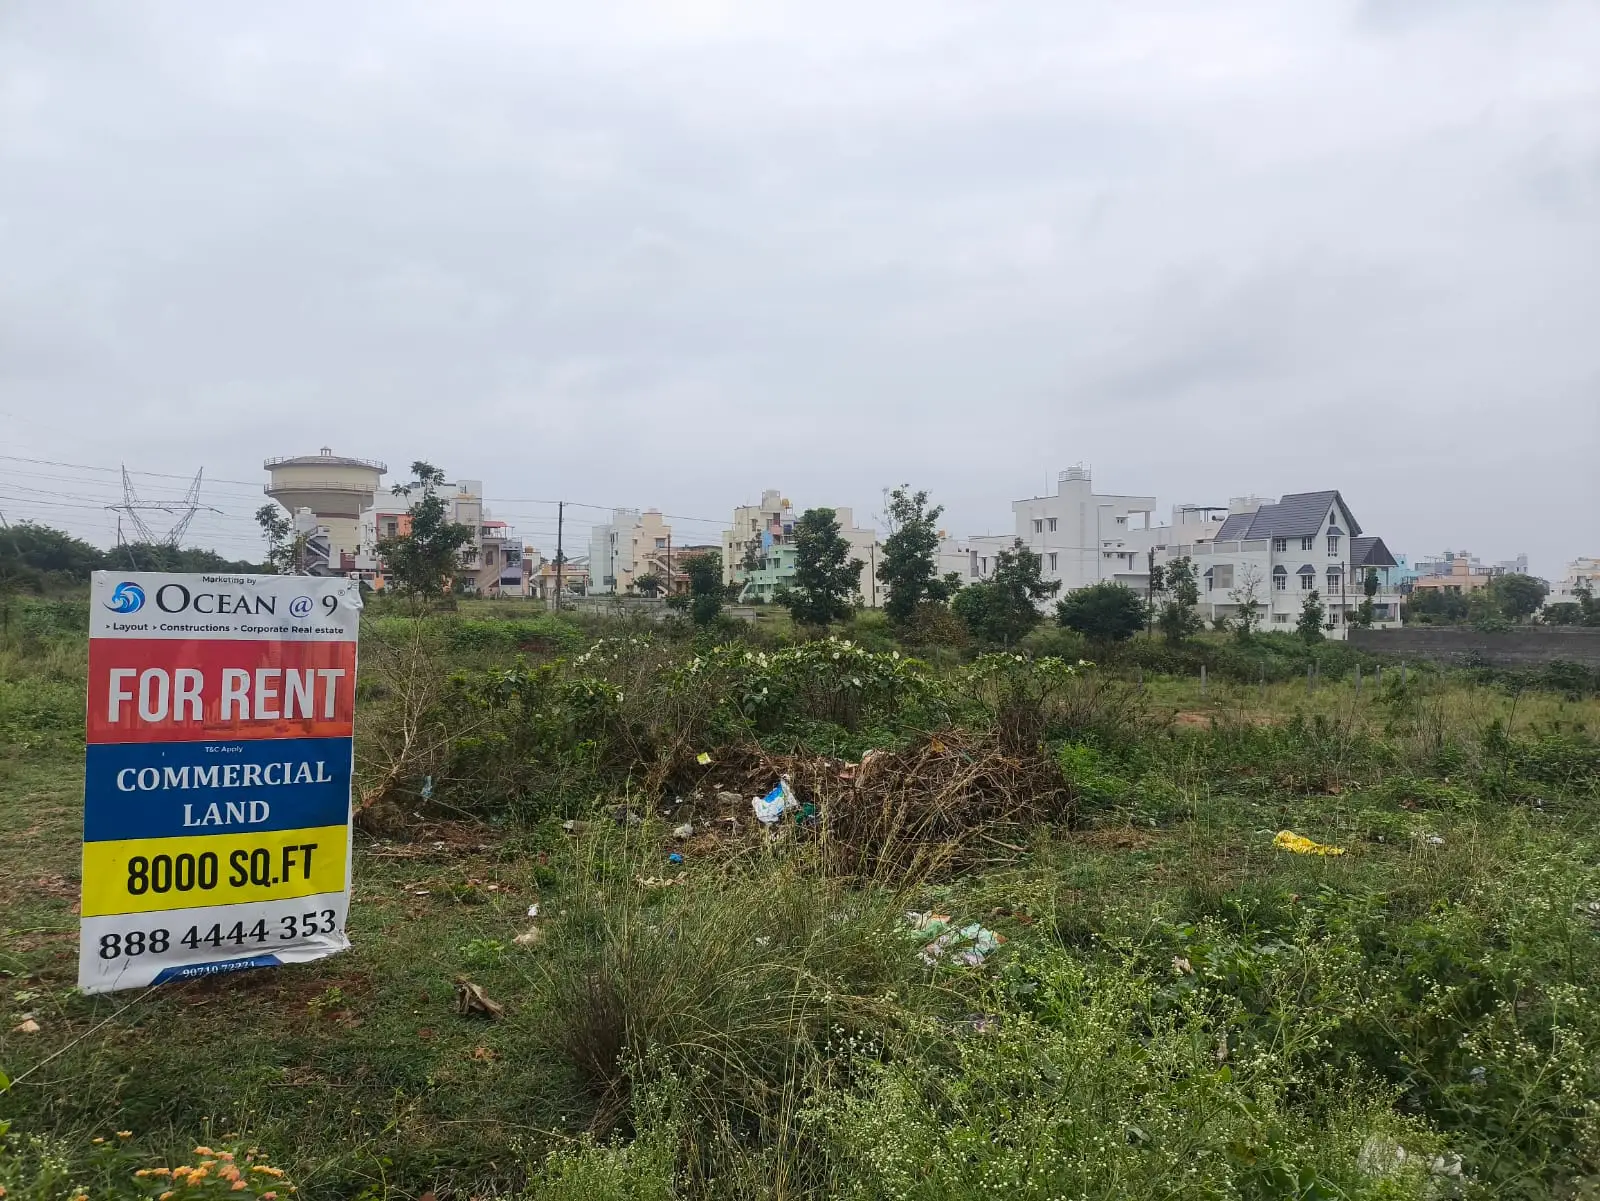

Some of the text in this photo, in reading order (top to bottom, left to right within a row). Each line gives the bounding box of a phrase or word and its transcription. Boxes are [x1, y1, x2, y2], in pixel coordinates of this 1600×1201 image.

[202, 576, 257, 586] Marketing by
[289, 596, 314, 618] @
[113, 623, 344, 635] Layout Constructions Corporate Real estate
[108, 668, 345, 723] FOR RENT
[221, 745, 243, 754] Apply
[116, 761, 332, 792] COMMERCIAL
[183, 800, 270, 827] LAND
[127, 843, 318, 896] 8000 SQ.FT
[99, 909, 337, 960] 888 4444 353
